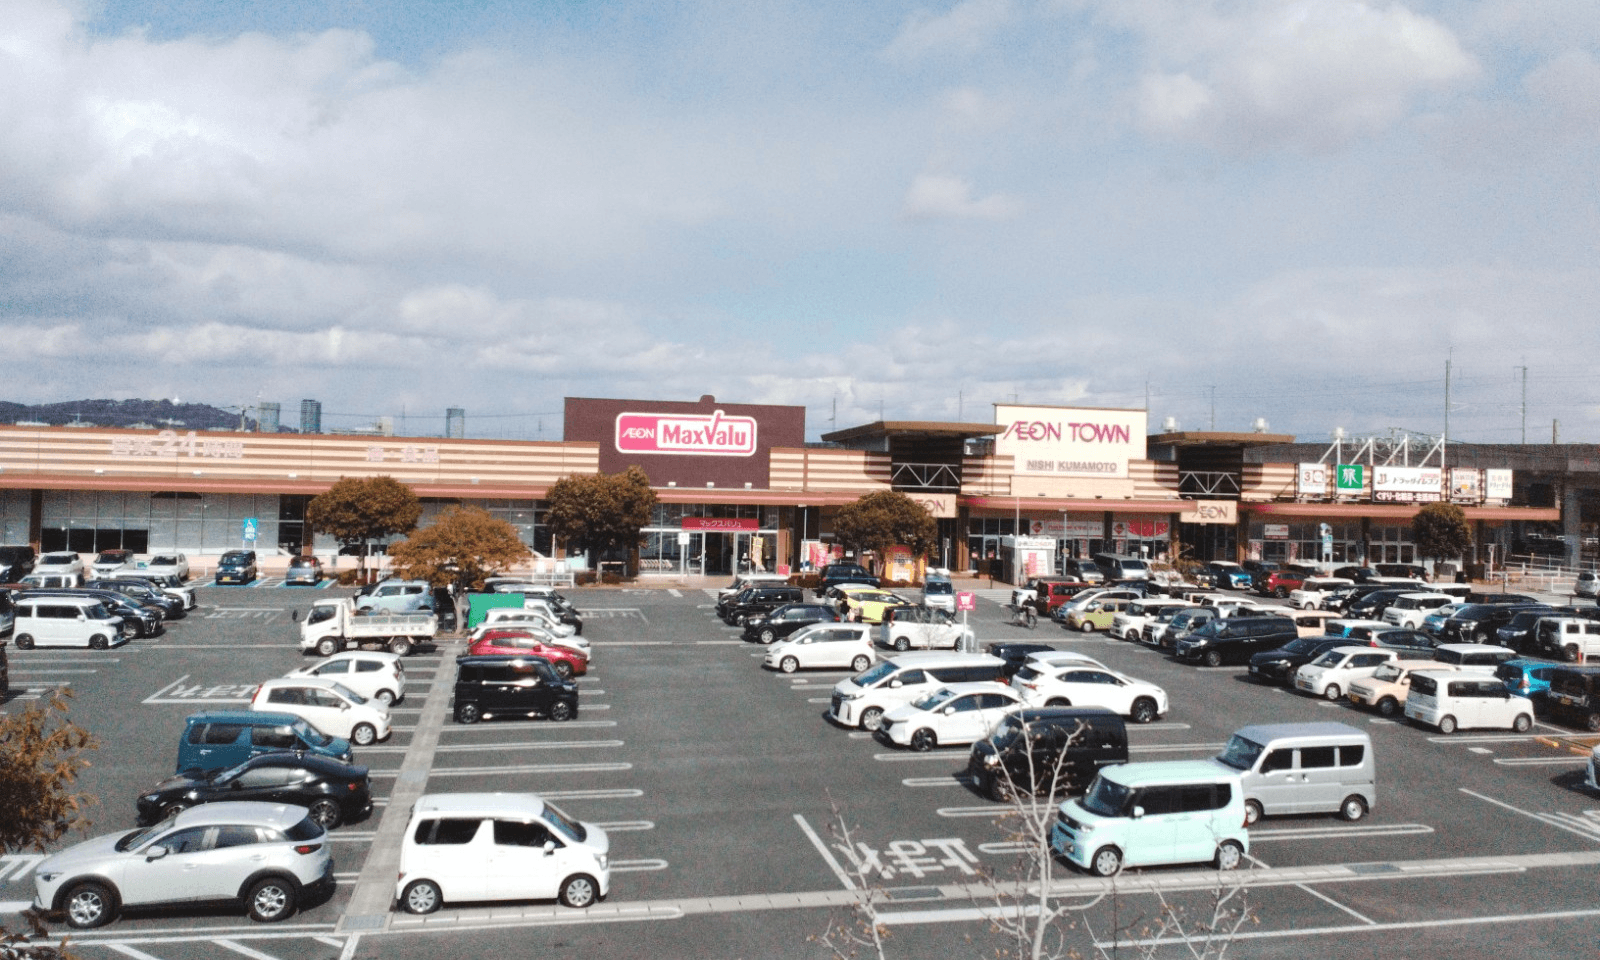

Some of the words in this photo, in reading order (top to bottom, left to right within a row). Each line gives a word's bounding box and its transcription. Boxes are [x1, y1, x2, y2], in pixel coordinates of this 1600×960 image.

[662, 413, 747, 446] MaxValu
[1068, 422, 1130, 443] TOWN
[1026, 460, 1054, 471] NISHI
[1057, 461, 1117, 473] KUMAMOTO
